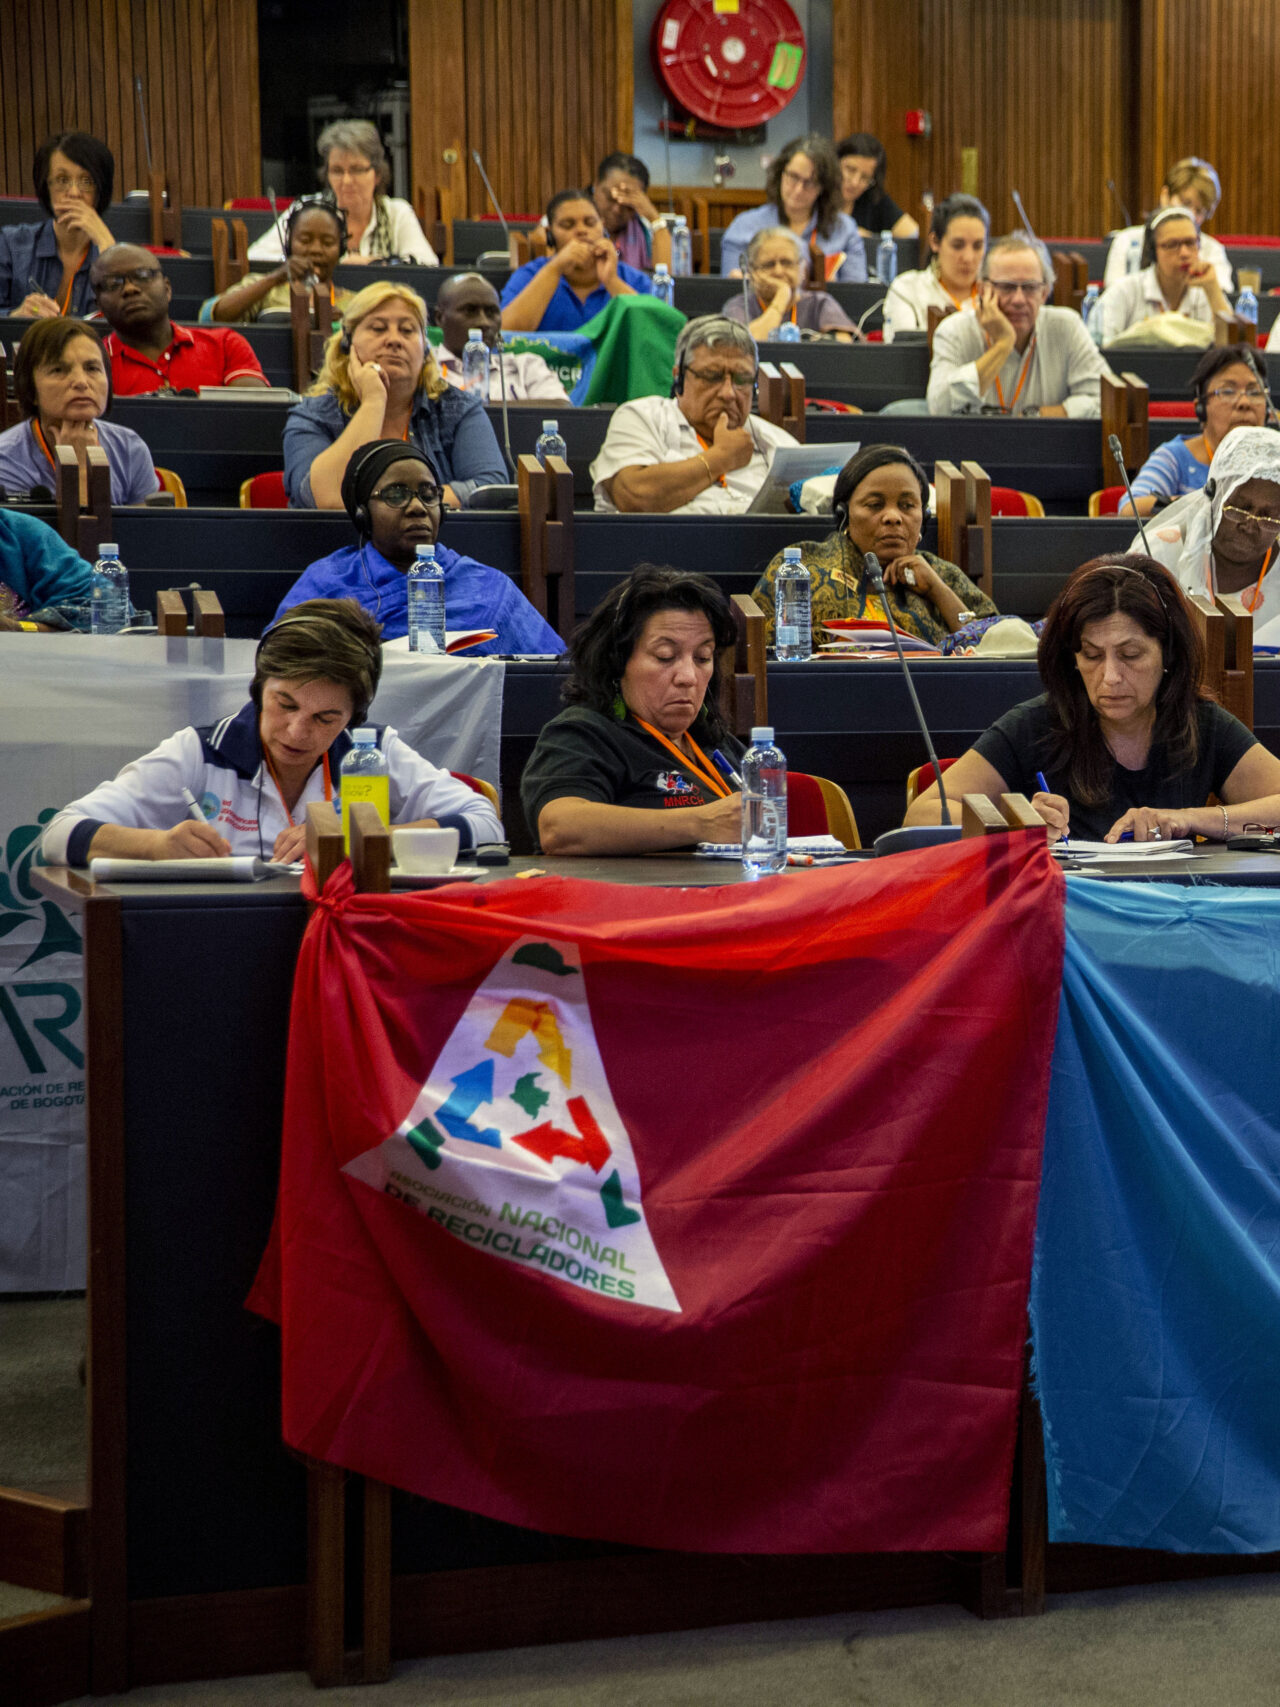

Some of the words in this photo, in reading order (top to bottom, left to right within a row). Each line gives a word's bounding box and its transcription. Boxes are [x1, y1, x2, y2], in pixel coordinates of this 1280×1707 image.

[663, 795, 704, 807] MNRCH
[46, 1083, 65, 1094] DE
[10, 1099, 30, 1110] DE
[499, 1201, 637, 1275] NACIONAL
[427, 1205, 636, 1300] RECICLADORES
